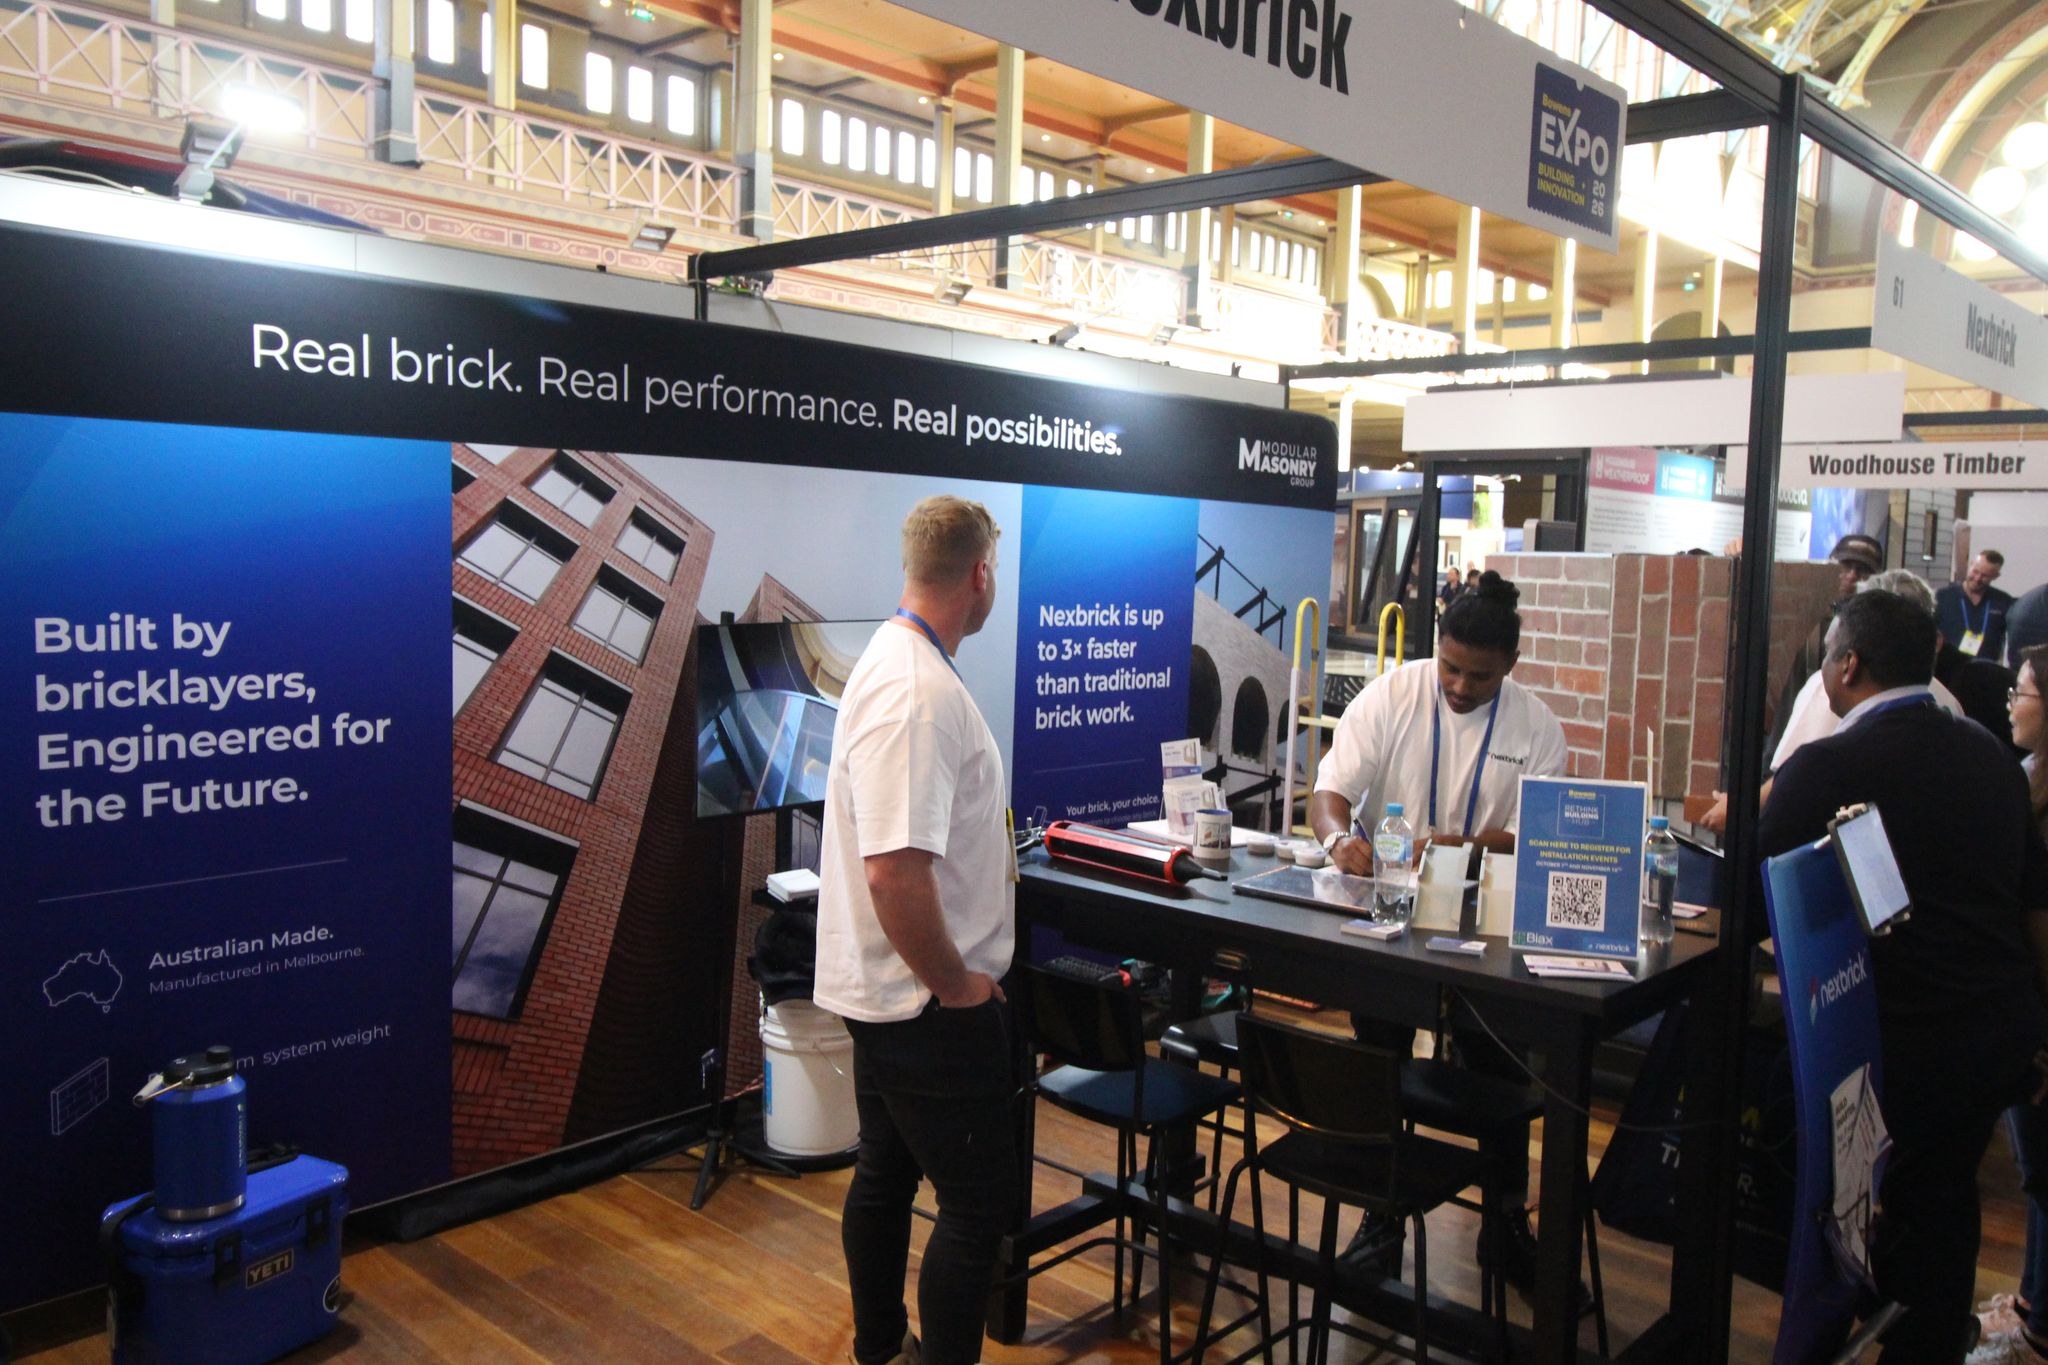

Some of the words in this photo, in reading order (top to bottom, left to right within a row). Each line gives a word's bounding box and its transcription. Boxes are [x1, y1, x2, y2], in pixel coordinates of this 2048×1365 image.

[1542, 92, 1572, 117] Bowens
[1539, 108, 1609, 176] EXPO
[1538, 162, 1575, 187] BUILDING
[1537, 178, 1585, 206] INNOVATION
[1593, 180, 1605, 199] 20
[1966, 301, 2017, 368] Nexbrick
[252, 323, 370, 379] Real
[391, 337, 523, 393] brick.
[539, 356, 629, 403] Real
[645, 374, 884, 429] performance.
[893, 399, 957, 437] Real
[965, 413, 1122, 456] possibilities.
[1238, 437, 1317, 477] MASONRY
[1262, 441, 1317, 459] MODULAR
[1809, 454, 1935, 475] Woodhouse
[1943, 453, 2025, 474] Timber
[1290, 477, 1315, 487] GROUP
[1039, 603, 1120, 627] Nexbrick
[1125, 603, 1138, 626] is
[1142, 608, 1164, 630] up
[35, 612, 158, 654] Built
[172, 613, 231, 657] by
[1038, 640, 1057, 661] to
[1087, 637, 1137, 660] faster
[35, 668, 317, 712] bricklayers,
[1036, 672, 1079, 695] than
[1084, 666, 1171, 692] traditional
[1036, 704, 1082, 729] brick
[1086, 701, 1134, 725] work.
[38, 714, 321, 773] Engineered
[331, 712, 391, 747] for
[35, 789, 126, 828] the
[142, 776, 309, 818] Future.
[1066, 805, 1085, 816] Your
[1088, 801, 1111, 814] brick,
[1112, 799, 1130, 812] your
[1132, 794, 1159, 806] choice.
[1565, 804, 1598, 814] RETHINK
[1565, 811, 1599, 820] BUILDING
[1528, 839, 1549, 847] SCAN
[1550, 841, 1568, 849] HERE
[1570, 842, 1580, 850] TO
[1580, 843, 1614, 853] REGISTER
[1616, 846, 1631, 854] FOR
[1540, 850, 1590, 861] INSTALLATION
[1590, 854, 1618, 863] EVENTS
[149, 937, 264, 970] Australian
[271, 925, 334, 950] Made.
[149, 963, 262, 994] Manufactured
[265, 960, 280, 975] in
[284, 947, 365, 971] Melbourne.
[1820, 951, 1868, 1009] nexbrick
[263, 1039, 327, 1066] system
[332, 1024, 392, 1051] weight
[250, 1254, 290, 1281] YETI
